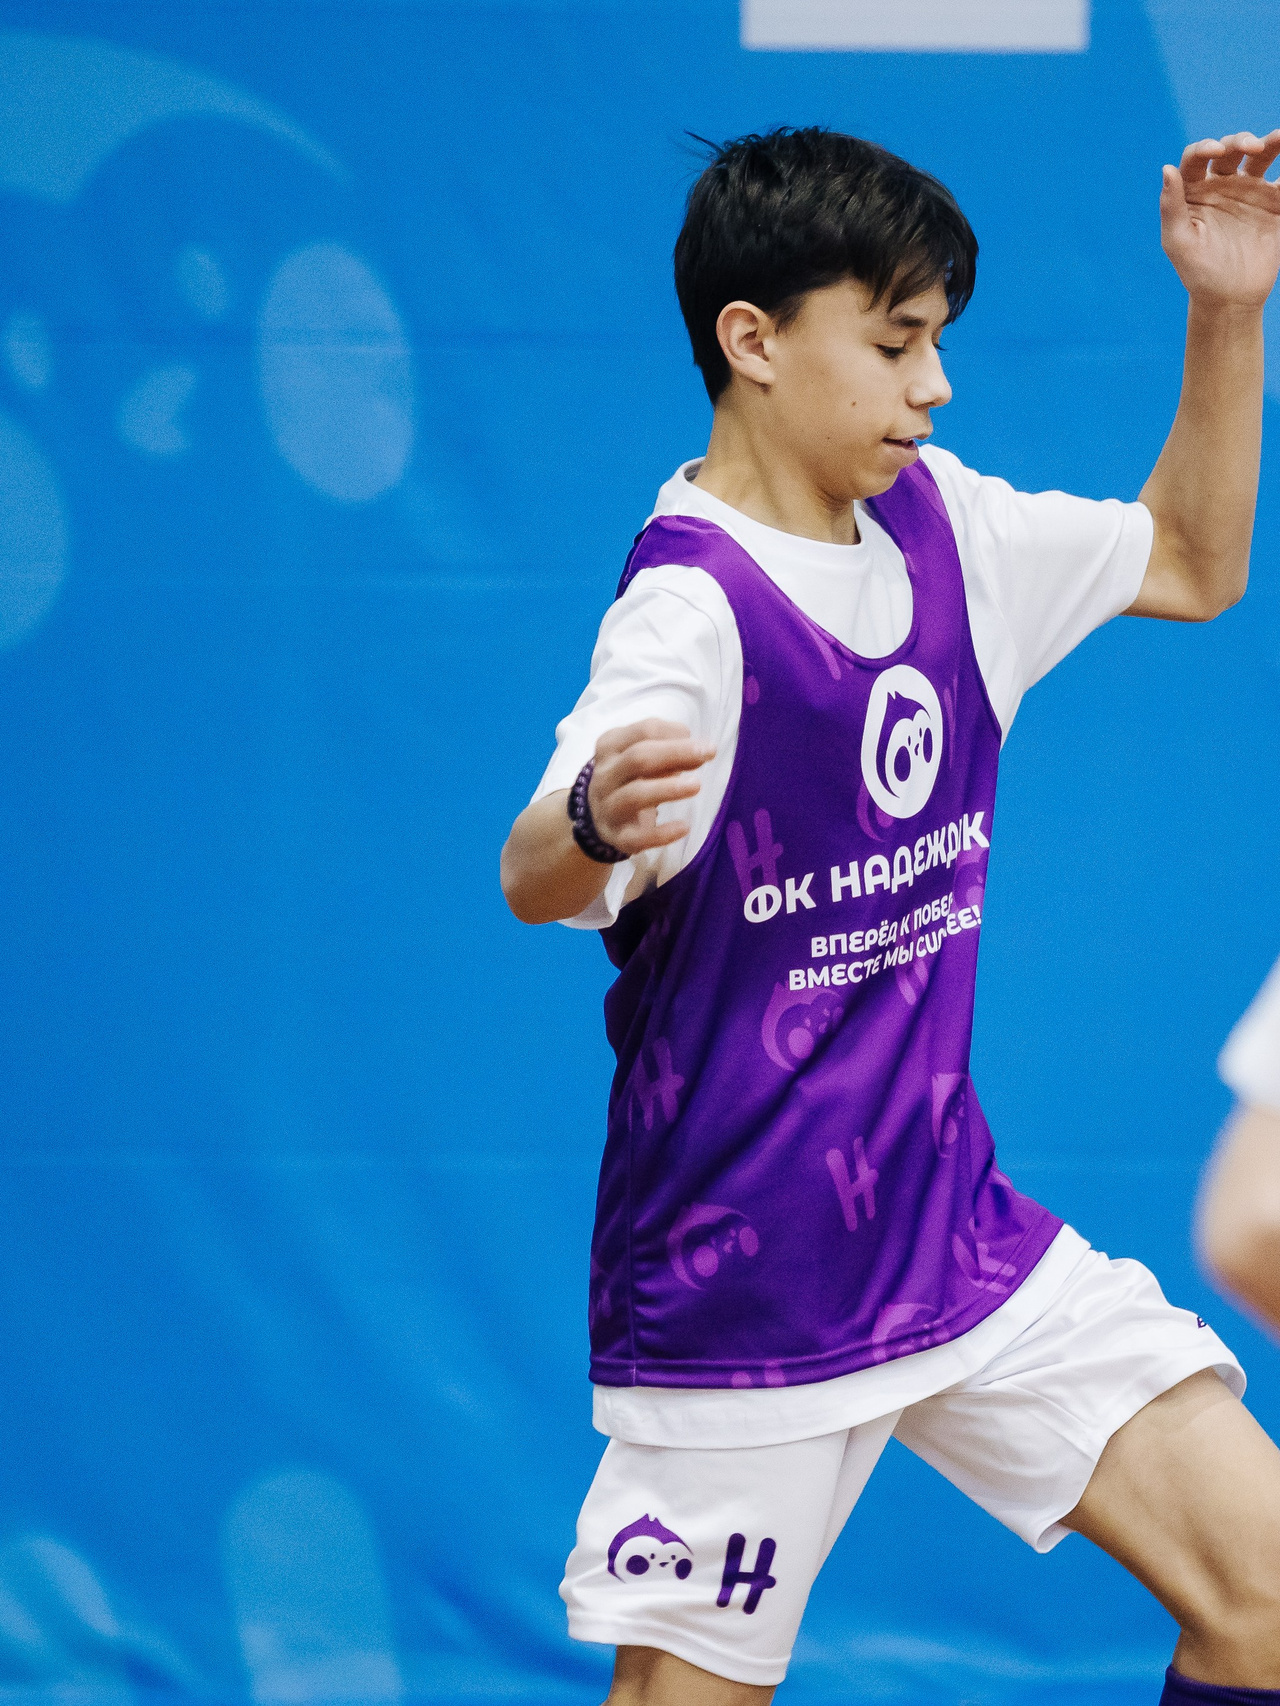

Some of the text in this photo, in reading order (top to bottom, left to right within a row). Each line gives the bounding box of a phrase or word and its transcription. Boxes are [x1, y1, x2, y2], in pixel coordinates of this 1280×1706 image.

[744, 873, 817, 923] ФК
[811, 919, 898, 958] ВПЕРЁД
[900, 913, 910, 936] К
[789, 954, 882, 991] ВМЕСТЕ
[883, 941, 914, 970] МЫ
[716, 1532, 777, 1615] Н
